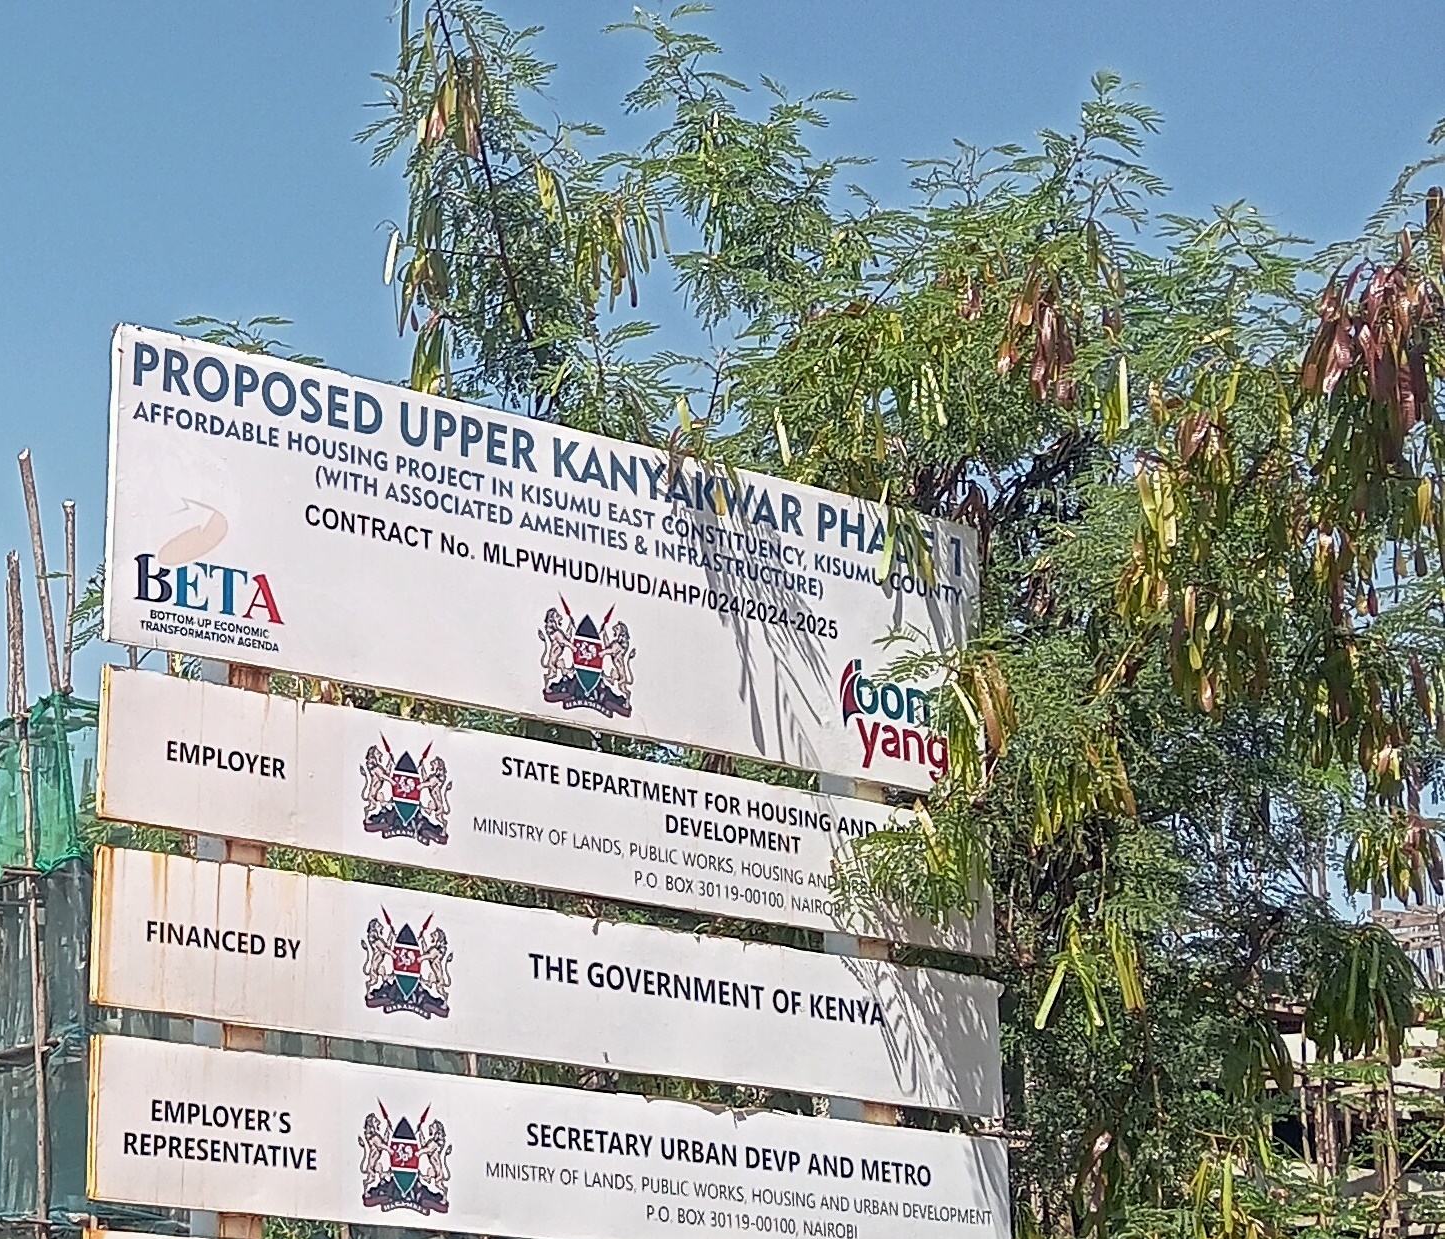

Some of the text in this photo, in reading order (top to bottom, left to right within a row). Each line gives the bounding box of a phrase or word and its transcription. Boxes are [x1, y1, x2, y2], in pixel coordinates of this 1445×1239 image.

[133, 342, 383, 435] PROPOSED
[400, 402, 538, 474] UPPER
[553, 436, 804, 537] KANYAKWAR
[950, 537, 963, 577] 1
[133, 401, 963, 602] AFFORDABLE HOUSING PROJECT IN KISUMU EAST CONSTITUENCY, KISUMU COUNTY
[315, 465, 824, 600] (WITH ASSOCIATED AMENITIES & INFRASTRUCTURE)
[134, 553, 285, 625] BETA
[305, 504, 838, 639] CONTRACT No. MLPWHUD/HUD/AHP/024/2024-2025
[140, 619, 280, 653] TRANSFORMATION AGENDA
[214, 621, 270, 639] ECONOMIC
[166, 740, 286, 780] EMPLOYER
[502, 756, 560, 785] STATE
[567, 767, 698, 809] DEPARTMENT
[705, 792, 741, 816] FOR
[747, 799, 832, 833] HOUSING
[837, 816, 877, 838] AND
[473, 816, 544, 843] MINISTRY
[549, 829, 568, 846] OF
[572, 833, 625, 858] LANDS,
[630, 843, 678, 865] PUBLIC
[683, 851, 737, 876] WORKS,
[741, 860, 804, 886] HOUSING
[807, 872, 837, 889] AND
[665, 814, 801, 855] DEVELOPMENT
[634, 871, 659, 888] P.O.
[665, 876, 694, 895] BOX
[698, 881, 788, 911] 30119-00100,
[146, 920, 301, 960] FINANCED BY
[528, 953, 886, 1028] THE GOVERNMENT OF KENYA
[150, 1098, 292, 1134] EMPLOYER'S
[123, 1132, 318, 1171] REPRESENTATIVE
[526, 1123, 932, 1188] SECRETARY URBAN DEVP AND METRO
[486, 1161, 993, 1226] MINISTRY OF LANDS, PUBLIC WORKS, HOUSING AND URBAN DEVELOPMENT
[646, 1205, 858, 1239] P.O. BOX 30119-00100, NAIROBI
